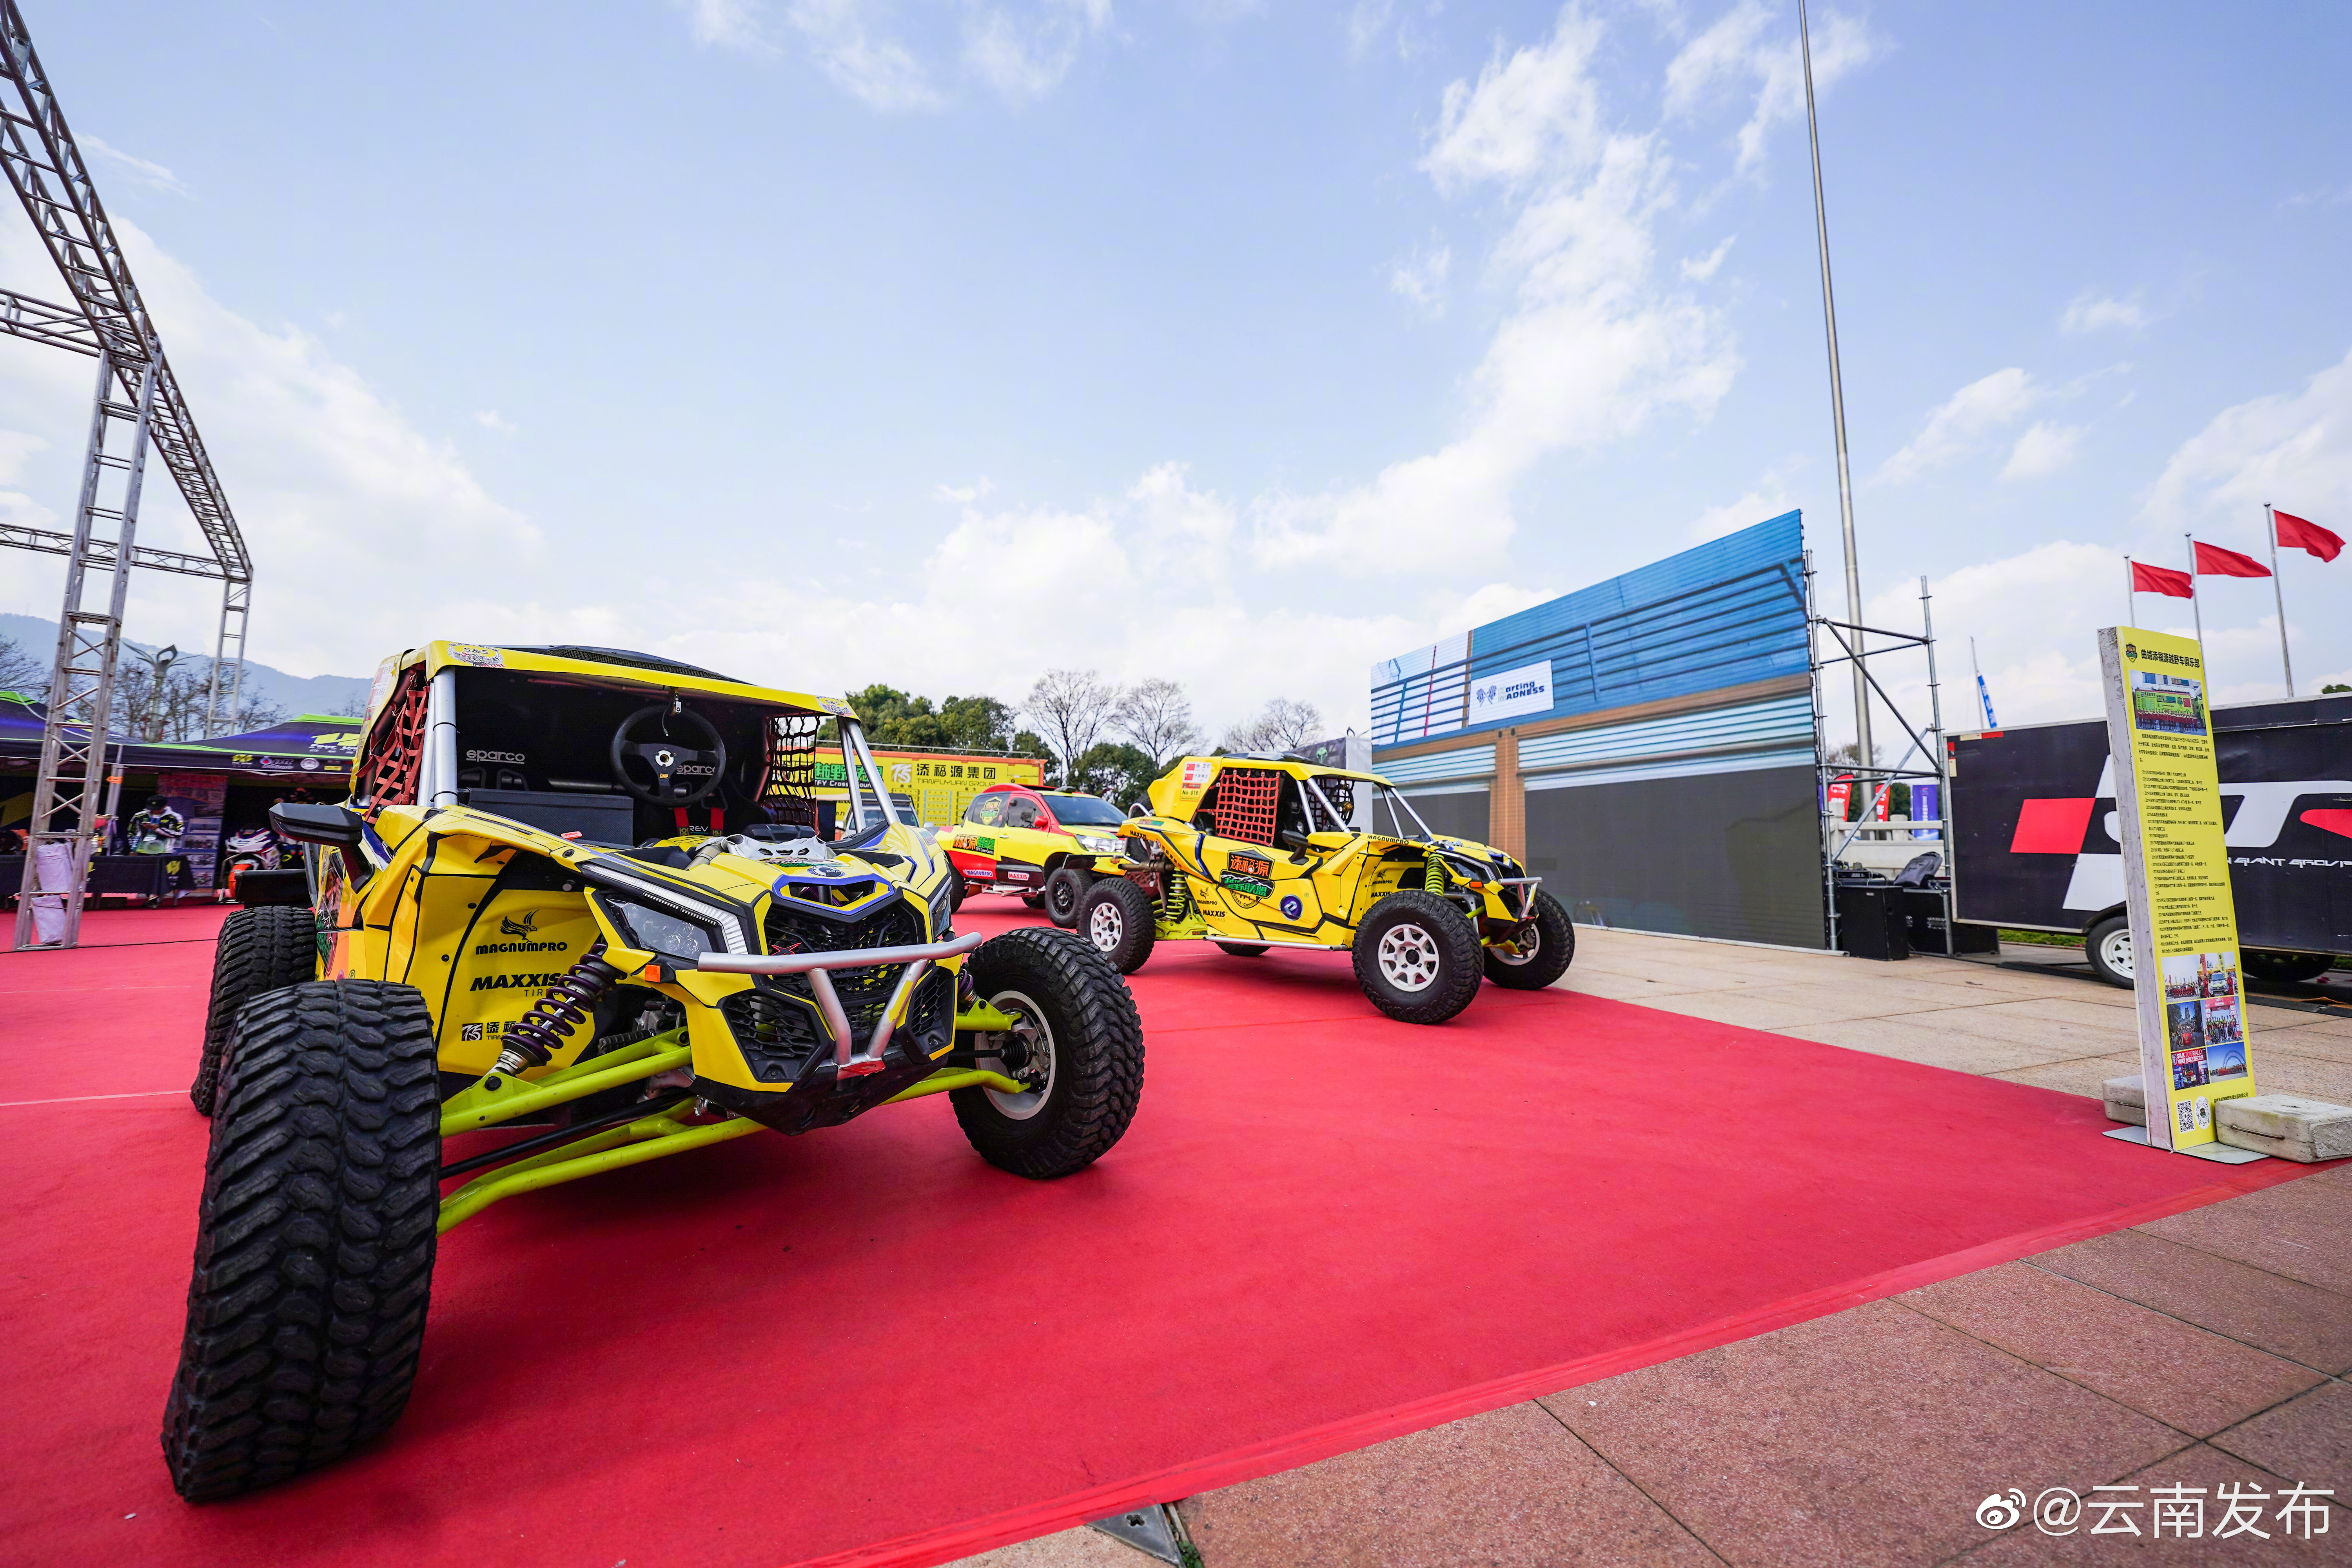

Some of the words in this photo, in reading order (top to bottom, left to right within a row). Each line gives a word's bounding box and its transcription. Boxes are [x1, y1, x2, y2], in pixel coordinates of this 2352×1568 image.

[2141, 649, 2200, 668] 曲靖添福源越野车俱乐部
[466, 750, 525, 763] sparco
[676, 765, 715, 775] sparc
[916, 763, 996, 779] 添福源集团
[1130, 830, 1147, 840] MAXXIS
[1367, 835, 1409, 845] MAGNUMPRO
[1229, 855, 1270, 877] 添福源
[1203, 909, 1225, 917] MAXXIS
[475, 941, 568, 955] MAGNUMPRO
[469, 973, 562, 991] MAXXIS
